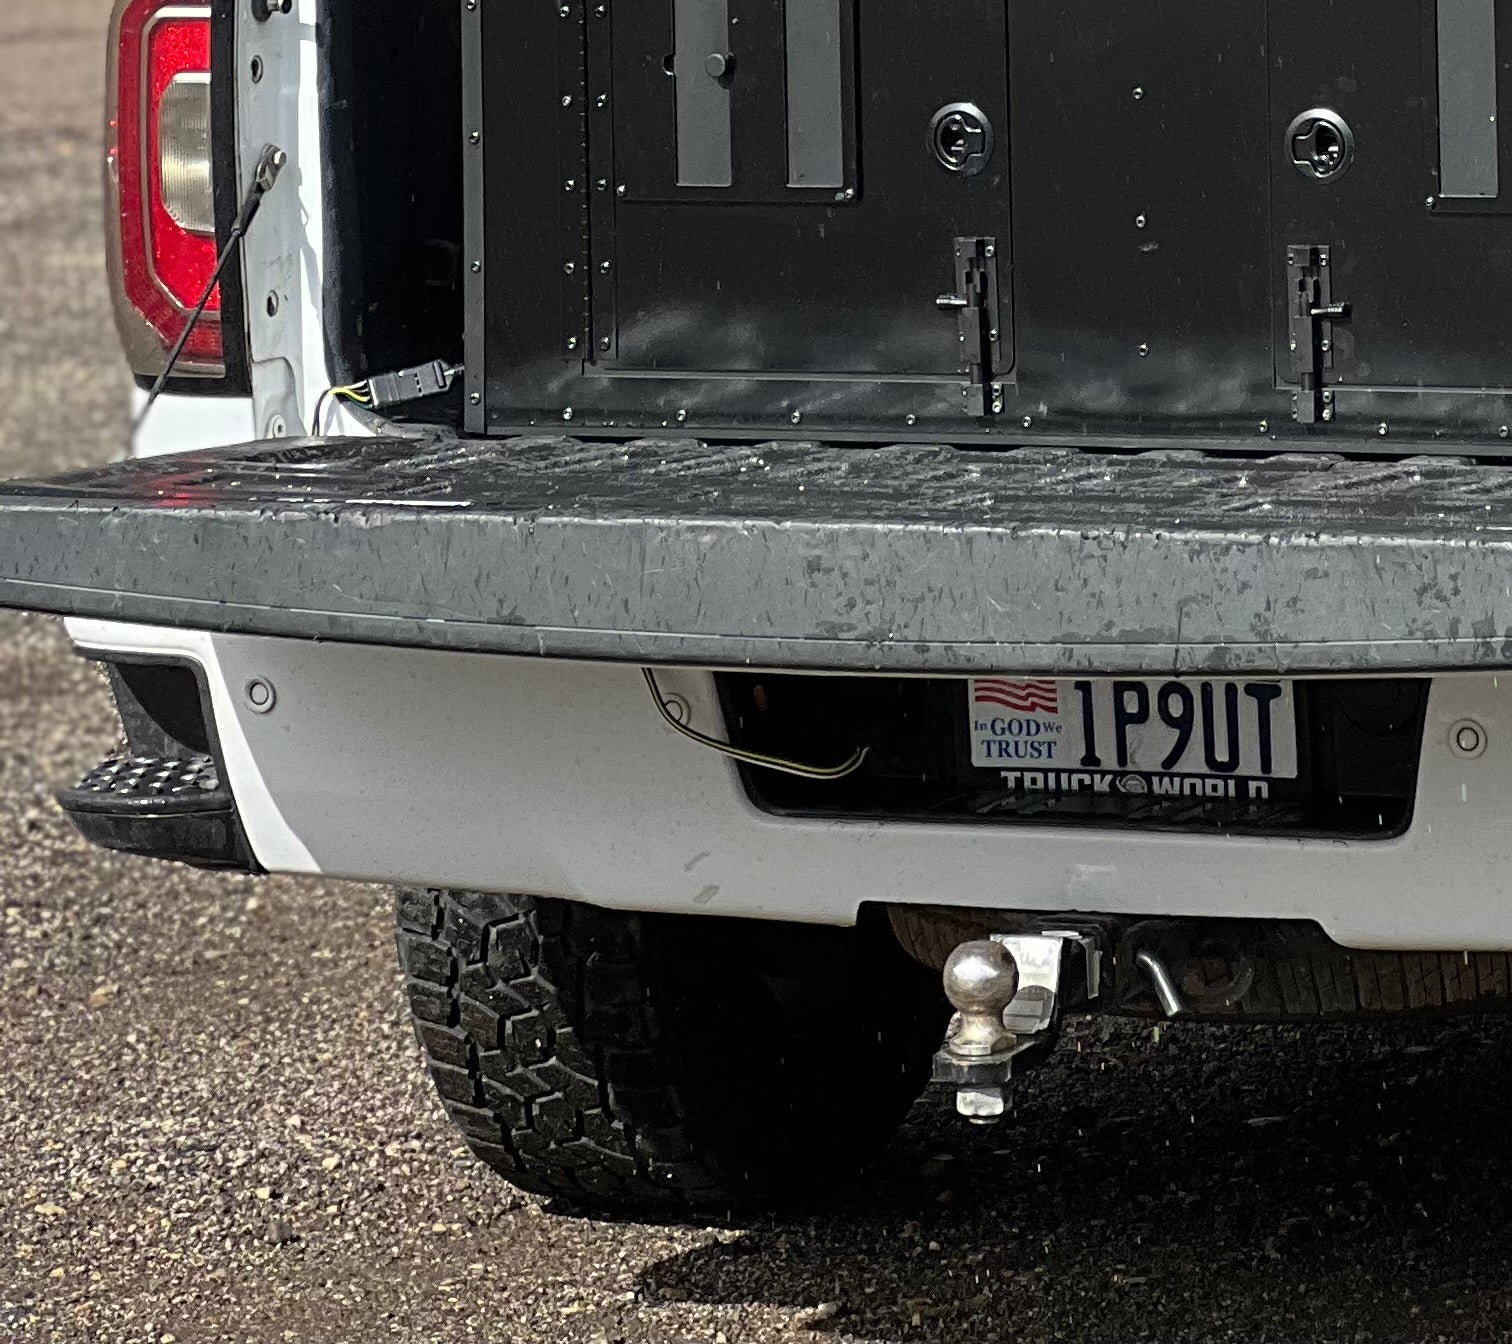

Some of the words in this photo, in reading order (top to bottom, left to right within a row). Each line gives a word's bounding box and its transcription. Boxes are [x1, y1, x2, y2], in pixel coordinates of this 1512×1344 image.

[974, 720, 988, 731] In
[990, 717, 1041, 737] GOD
[1042, 722, 1063, 734] We
[981, 739, 1058, 759] TRUST
